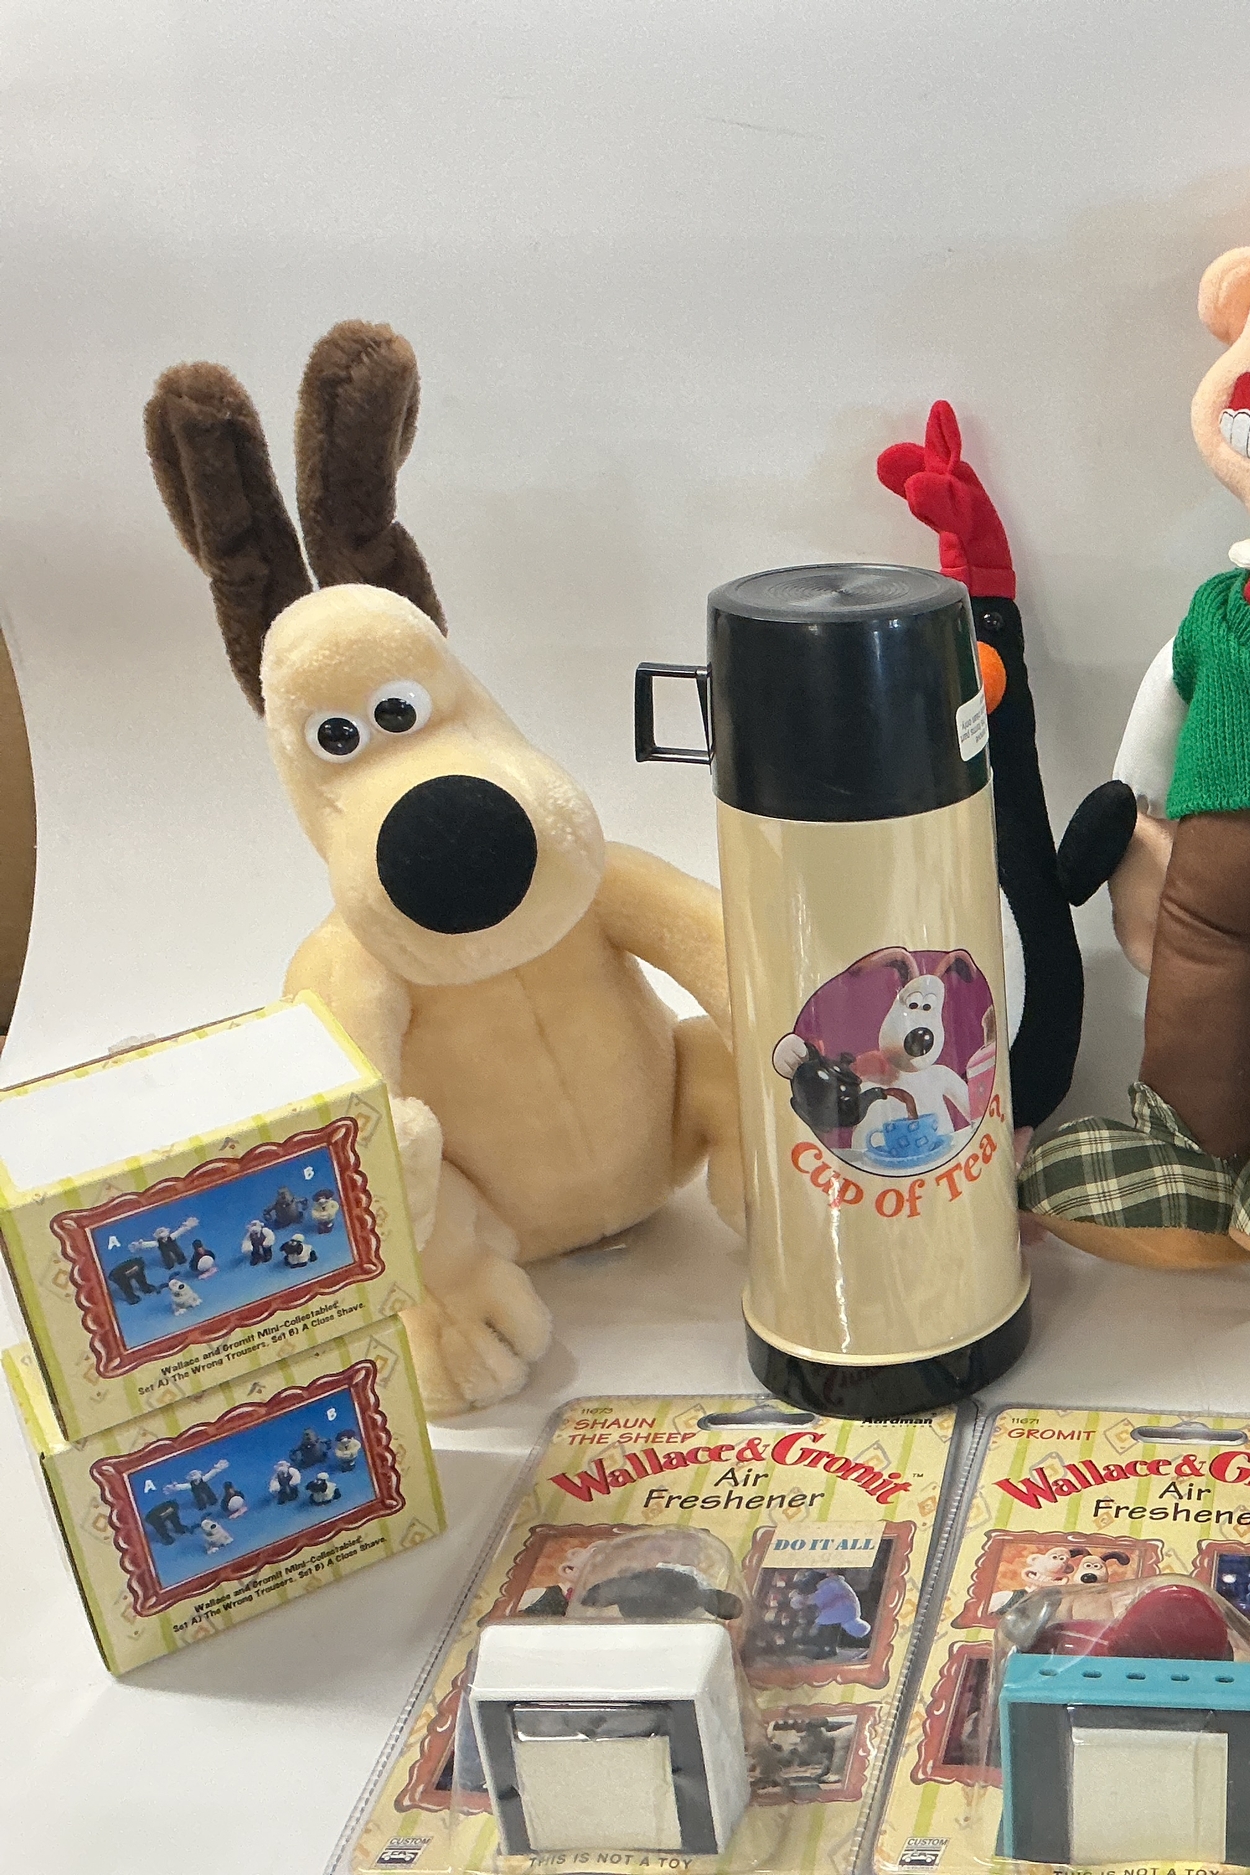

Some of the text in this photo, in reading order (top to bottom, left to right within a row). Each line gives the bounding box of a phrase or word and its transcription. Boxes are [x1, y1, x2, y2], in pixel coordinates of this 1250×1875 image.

[303, 1166, 315, 1181] B
[790, 1141, 864, 1209] Cup
[936, 1132, 997, 1202] Tea
[107, 1235, 121, 1250] A
[138, 1385, 155, 1396] Set
[172, 1370, 189, 1382] The
[191, 1356, 223, 1376] Wrong
[302, 1323, 310, 1332] A
[311, 1313, 335, 1328] Close
[161, 1356, 199, 1376] Wallace
[203, 1346, 221, 1360] and
[222, 1335, 255, 1352] Gromit
[326, 1407, 337, 1421] B
[574, 1418, 656, 1430] SHAUN
[569, 1432, 697, 1445] THE SHEEP
[1008, 1428, 1096, 1441] GROMIT
[547, 1431, 914, 1506] Wallace & Gromit
[714, 1466, 769, 1488] Air
[144, 1480, 157, 1494] A
[992, 1458, 1172, 1510] Wallace
[1173, 1454, 1206, 1478] &
[1158, 1481, 1211, 1501] Air
[643, 1488, 825, 1511] Freshener
[773, 1538, 875, 1551] DO IT ALL
[194, 1593, 231, 1614] Wallace
[233, 1583, 251, 1597] and
[252, 1571, 283, 1590] Gromit
[204, 1608, 220, 1620] The
[222, 1595, 254, 1612] Wrong
[327, 1558, 334, 1567] A
[336, 1548, 358, 1562] Close
[907, 1838, 948, 1846] CUSTOM
[528, 1852, 693, 1870] THIS IS NOT A TOY
